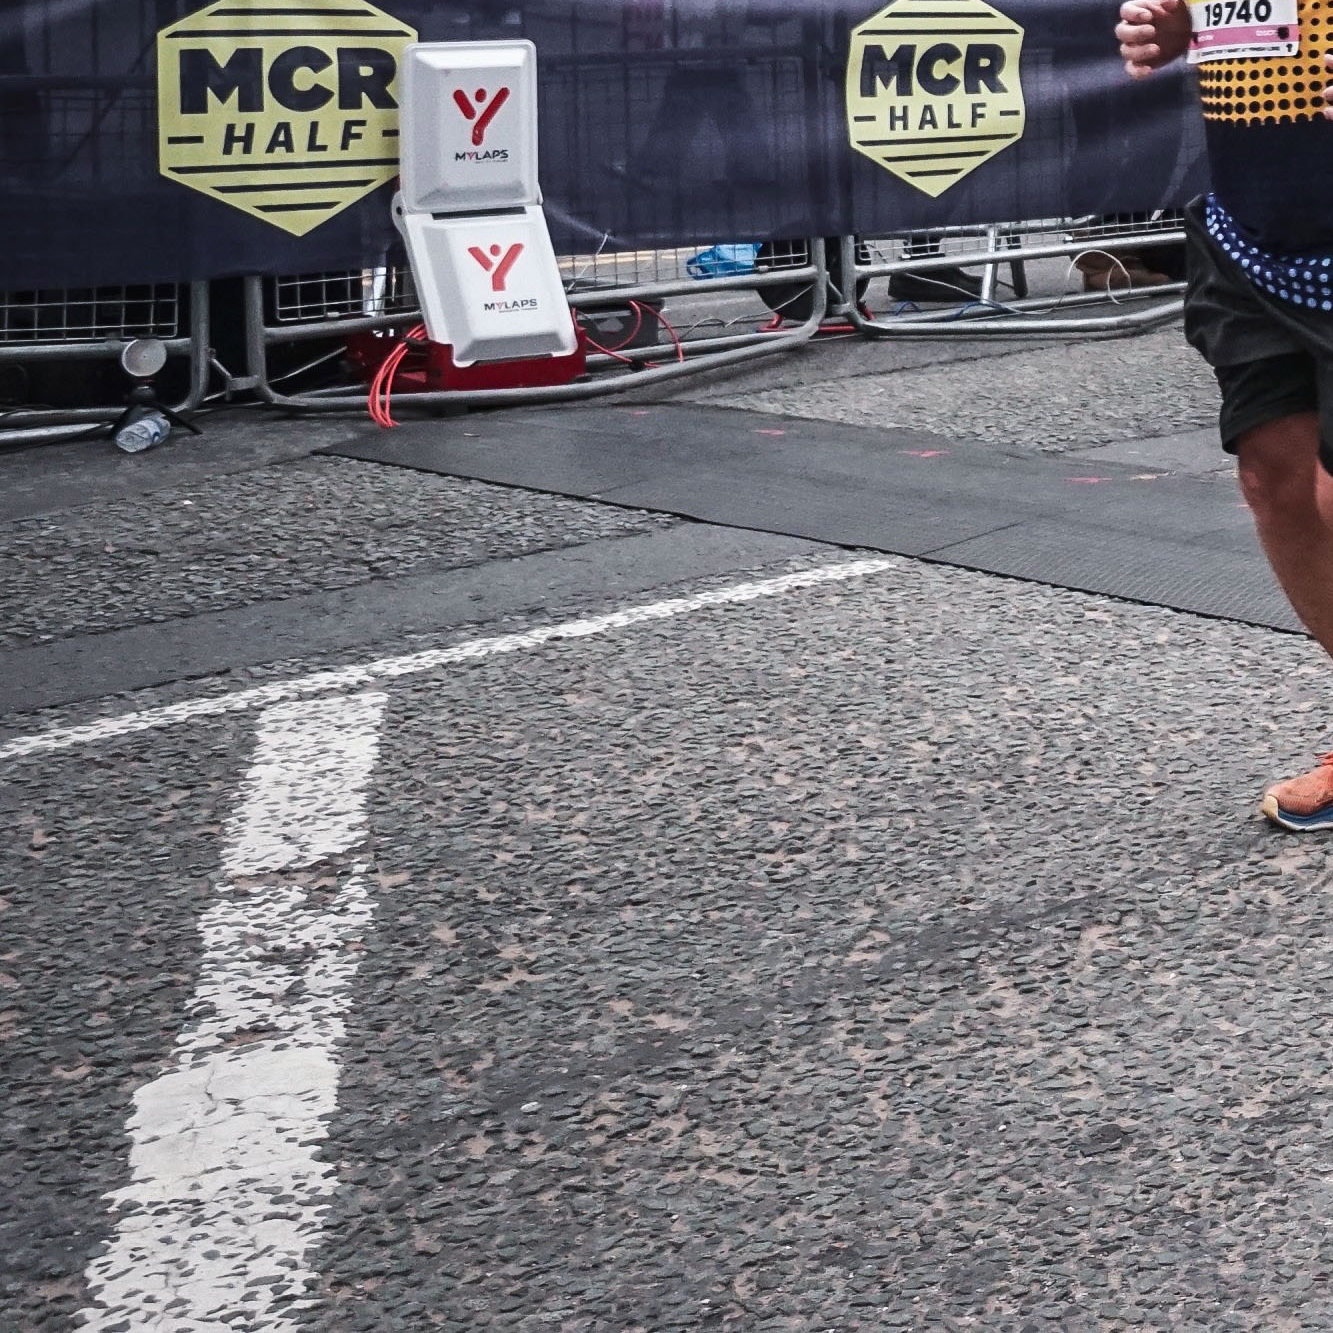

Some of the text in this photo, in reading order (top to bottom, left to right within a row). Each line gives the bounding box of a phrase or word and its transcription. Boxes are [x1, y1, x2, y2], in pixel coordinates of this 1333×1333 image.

[1205, 0, 1272, 26] 19740
[180, 46, 399, 114] MCR
[860, 43, 1009, 97] MCR
[889, 103, 988, 131] HALF
[222, 120, 366, 155] HALF
[455, 149, 509, 161] MYLAPS
[484, 299, 538, 311] MYLAPS
